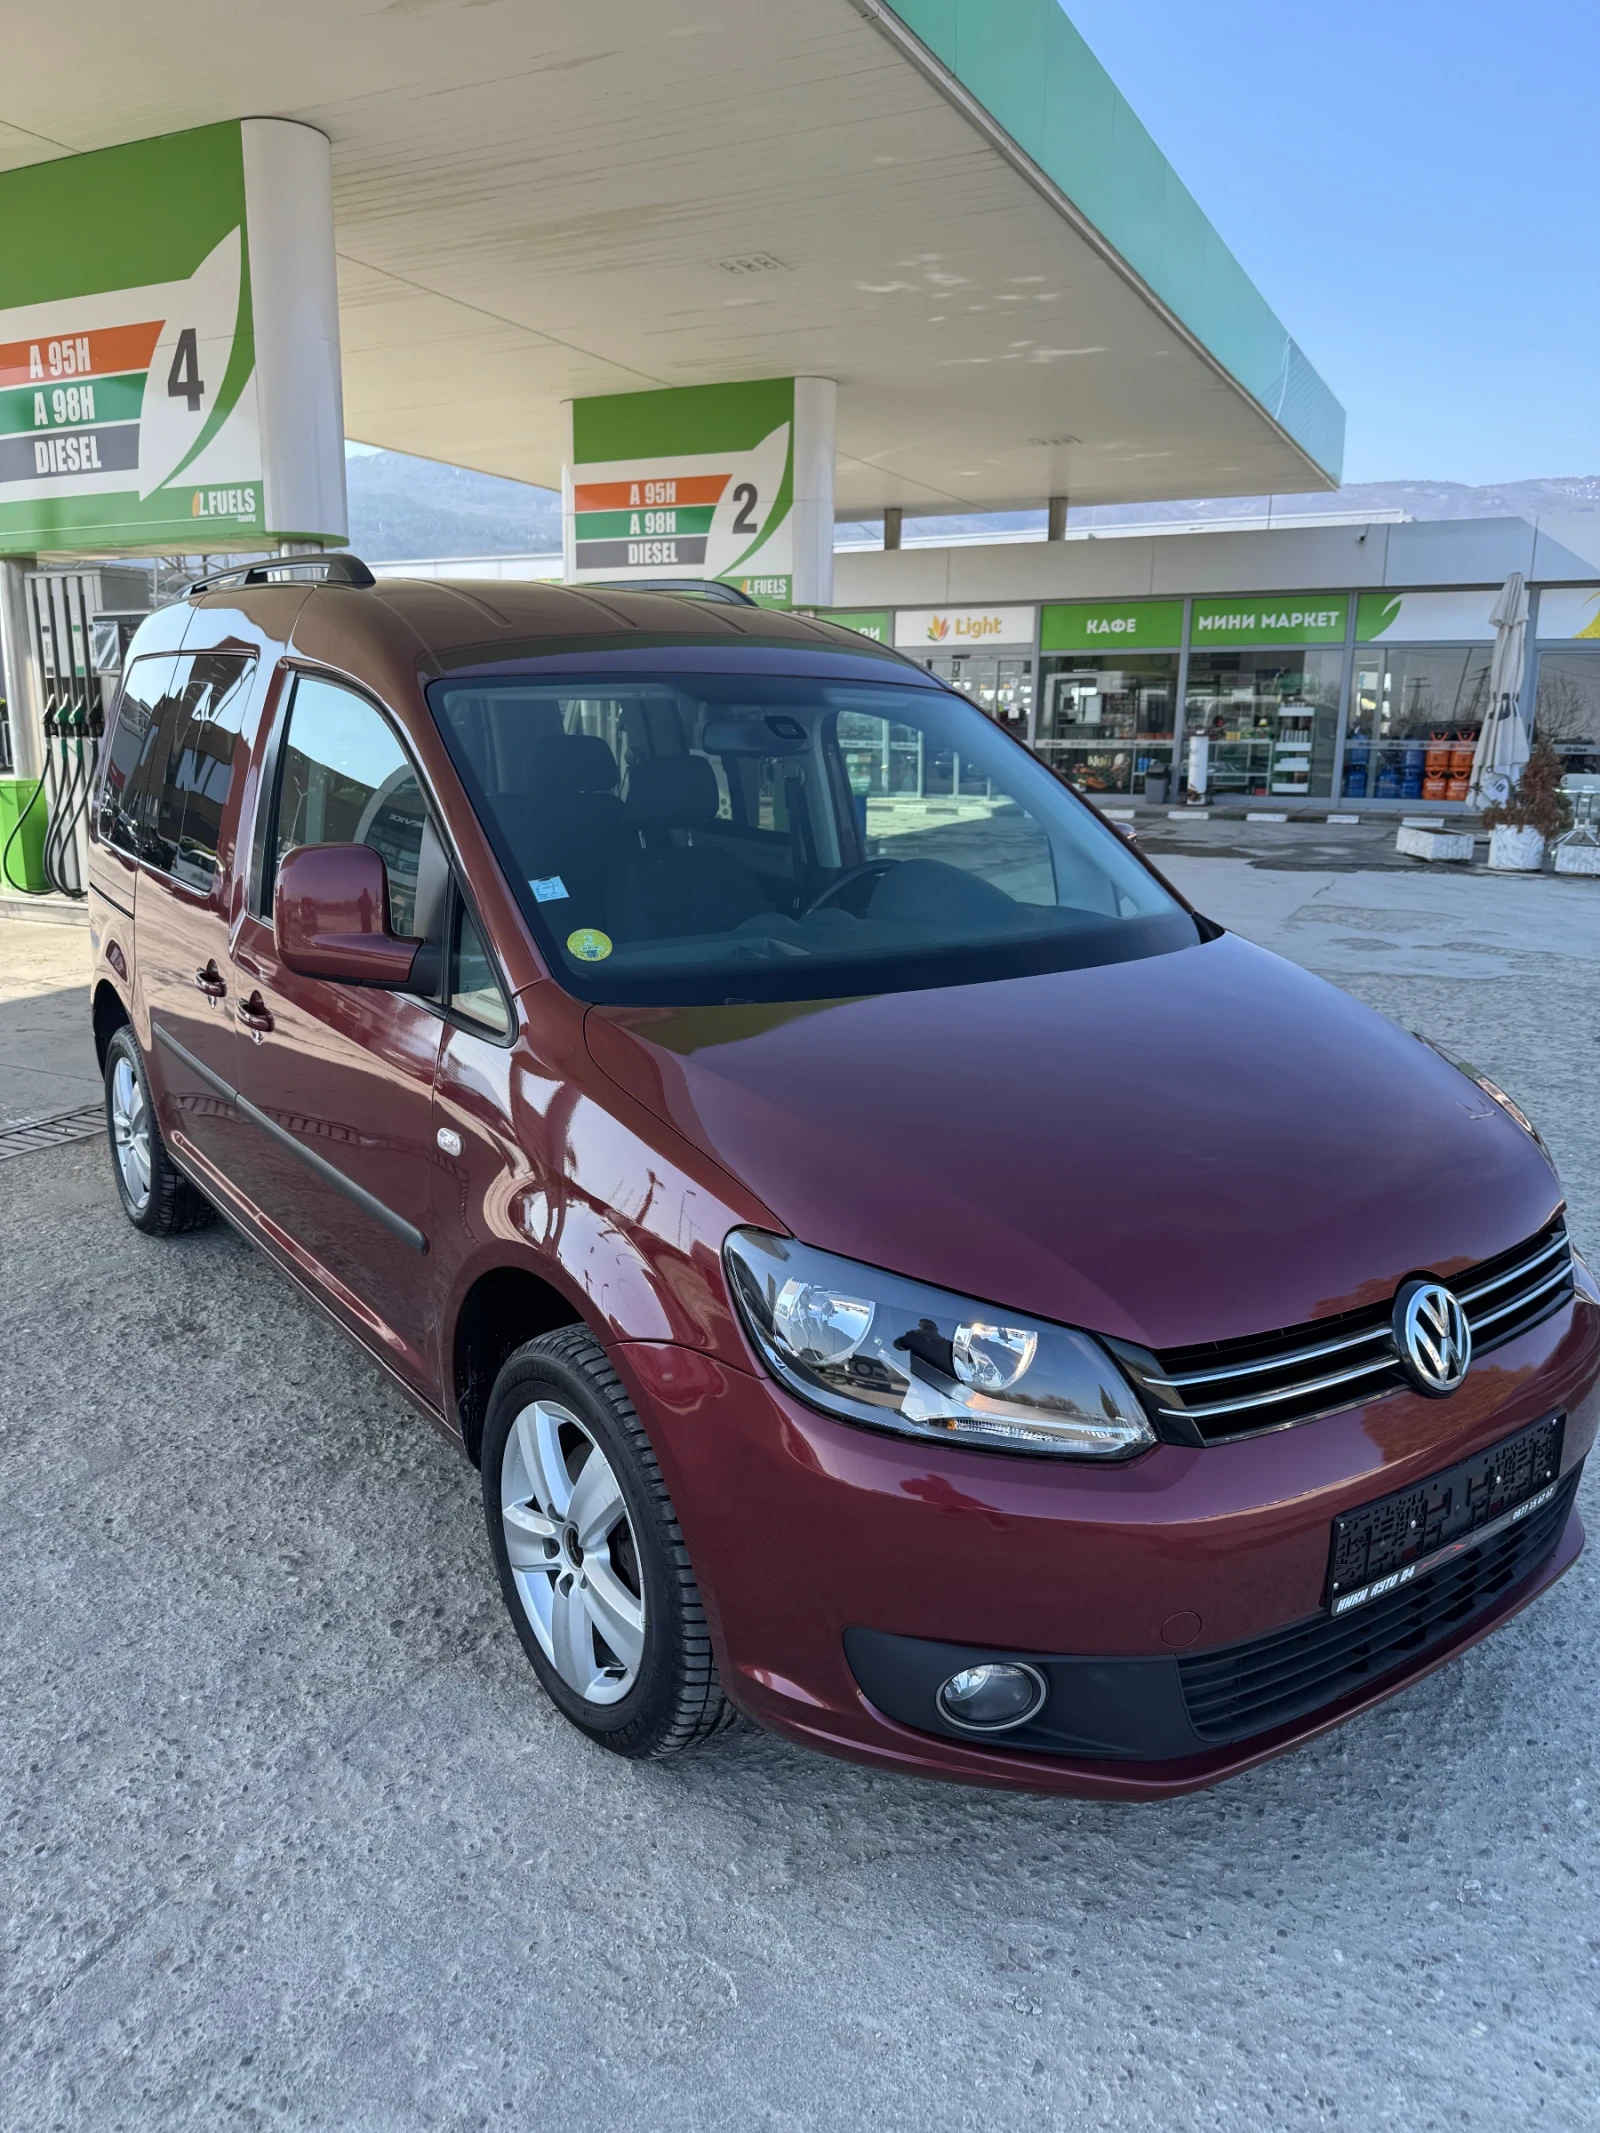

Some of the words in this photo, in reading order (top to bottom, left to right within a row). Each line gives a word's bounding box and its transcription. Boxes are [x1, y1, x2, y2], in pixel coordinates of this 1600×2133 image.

[29, 344, 44, 379] A
[48, 337, 91, 377] 95H
[167, 328, 205, 412] 4
[34, 391, 48, 426] A
[52, 385, 95, 424] 98H
[34, 435, 102, 474] DIESEL
[629, 483, 641, 505] A
[644, 482, 677, 504] 95H
[732, 482, 758, 534] 2
[629, 513, 641, 535] A
[644, 511, 677, 534] 98H
[628, 542, 678, 565] DIESEL
[955, 616, 1002, 639] Light
[1086, 618, 1137, 634] КАФЕ
[1198, 614, 1256, 631] МИНИ
[1261, 611, 1340, 628] МАРКЕТ
[1513, 1504, 1529, 1520] 0877
[1529, 1498, 1537, 1510] 15
[1336, 1588, 1369, 1613] НИКИ
[1370, 1574, 1399, 1597] АУТО
